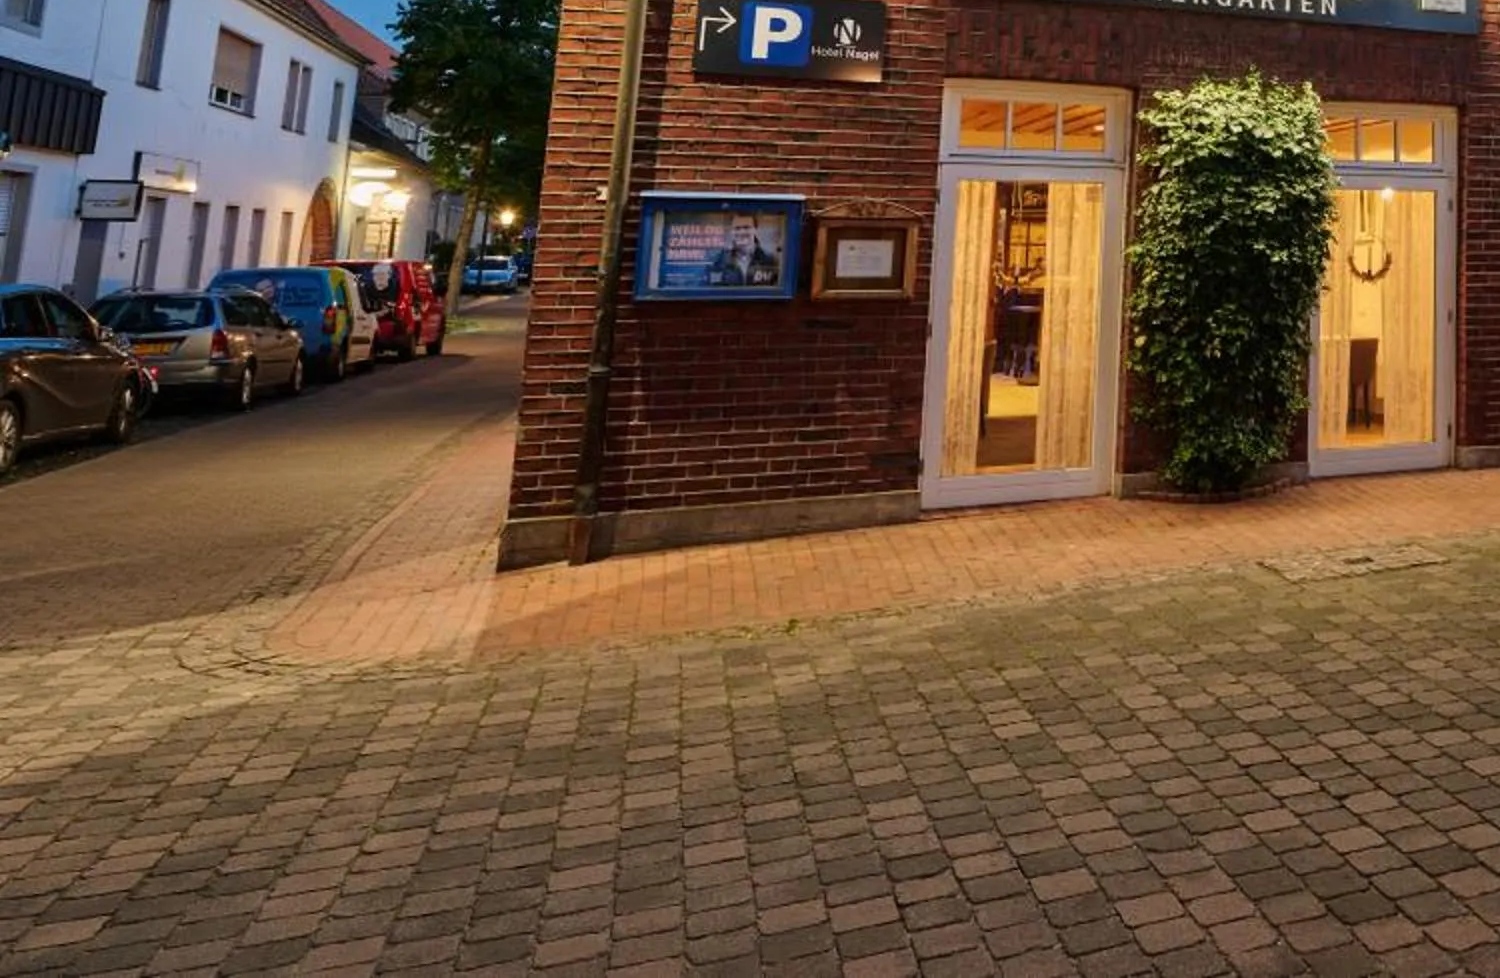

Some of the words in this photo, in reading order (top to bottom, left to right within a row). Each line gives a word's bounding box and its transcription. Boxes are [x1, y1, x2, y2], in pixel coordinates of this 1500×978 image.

[751, 5, 803, 59] P
[811, 45, 844, 59] Hotel
[845, 46, 880, 62] Nagel
